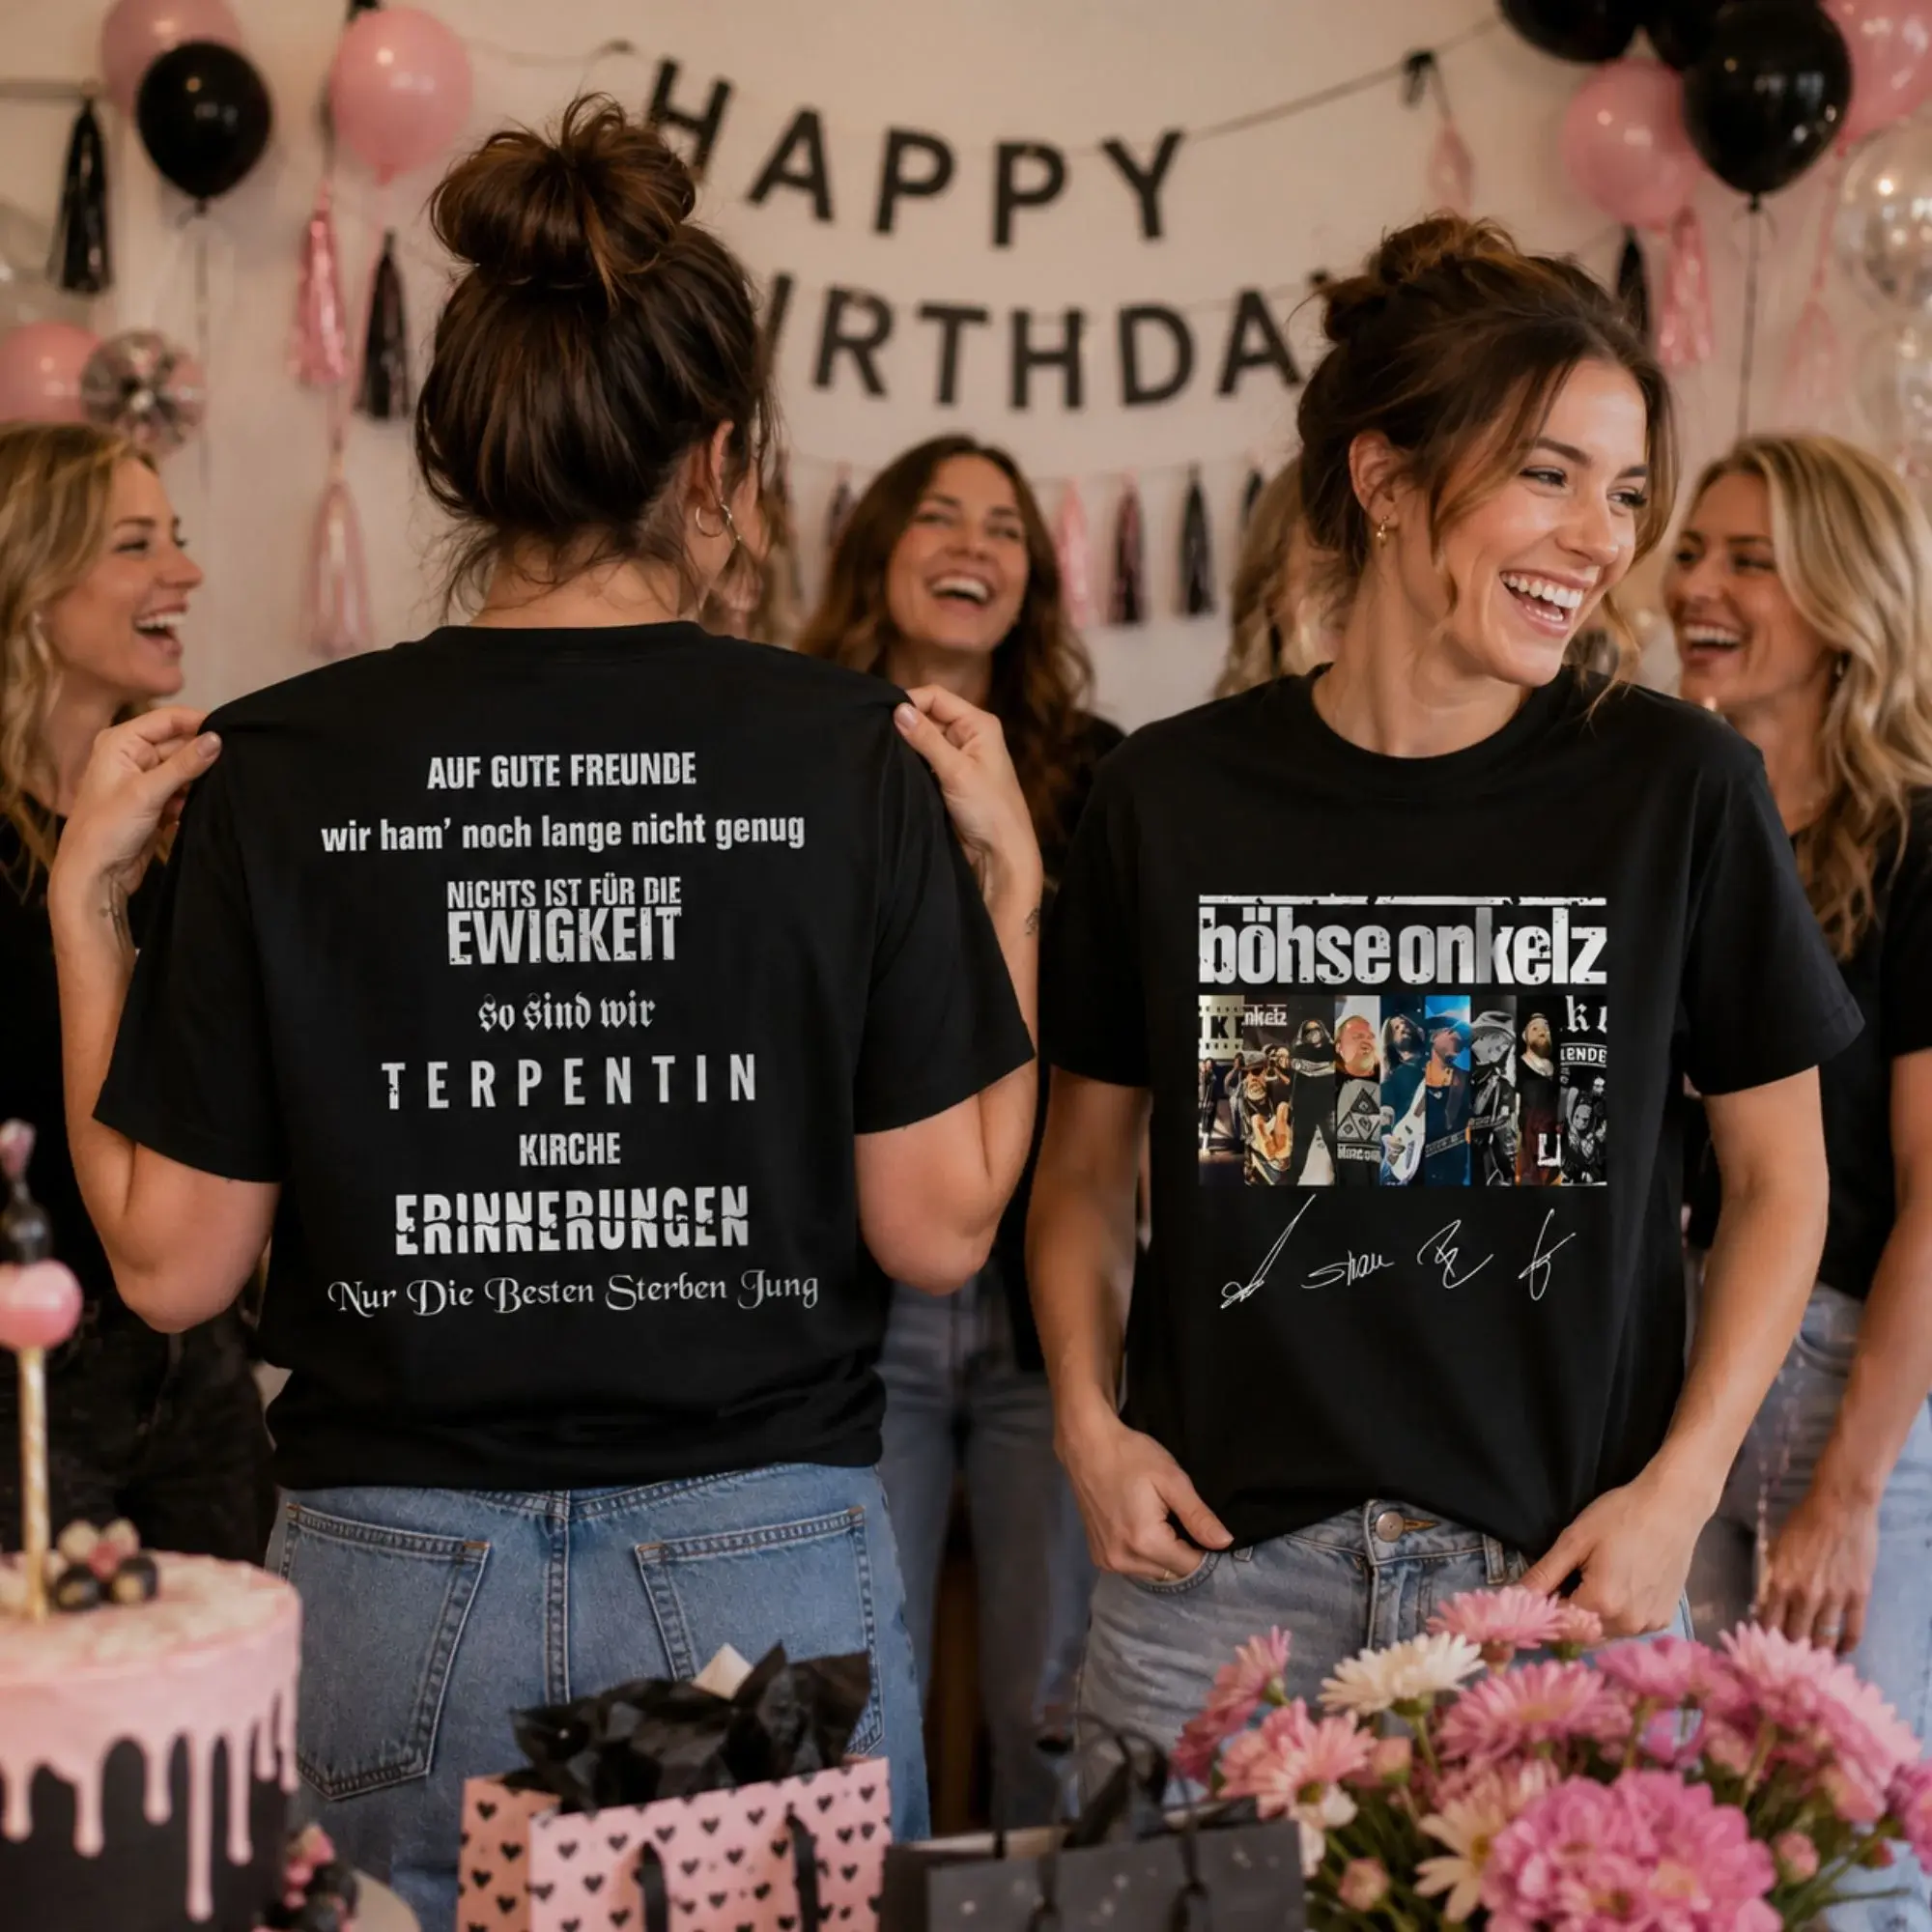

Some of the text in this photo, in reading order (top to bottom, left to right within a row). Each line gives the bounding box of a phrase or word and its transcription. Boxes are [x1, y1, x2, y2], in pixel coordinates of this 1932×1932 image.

[648, 58, 1185, 249] HAPPY
[770, 271, 1304, 410] IRTHDA
[426, 751, 697, 790] AUF GUTE FREUNDE
[321, 819, 372, 852] wir
[462, 815, 532, 849] noch
[541, 814, 622, 853] lange
[632, 811, 706, 845] nicht
[715, 816, 806, 850] genug
[544, 878, 582, 907] IST
[589, 871, 636, 906] FÜR
[643, 875, 682, 904] DIE
[447, 906, 682, 966] EWIGKEIT
[1199, 906, 1608, 985] böhse onkelz
[600, 989, 656, 1029] wir
[1241, 1006, 1288, 1027] nkelz
[381, 1053, 755, 1110] TERPENTIN
[519, 1131, 621, 1167] KIRCHE
[395, 1185, 749, 1256] ERINNERUNGEN
[327, 1268, 819, 1318] Nur Die Besten Sterben Jung
